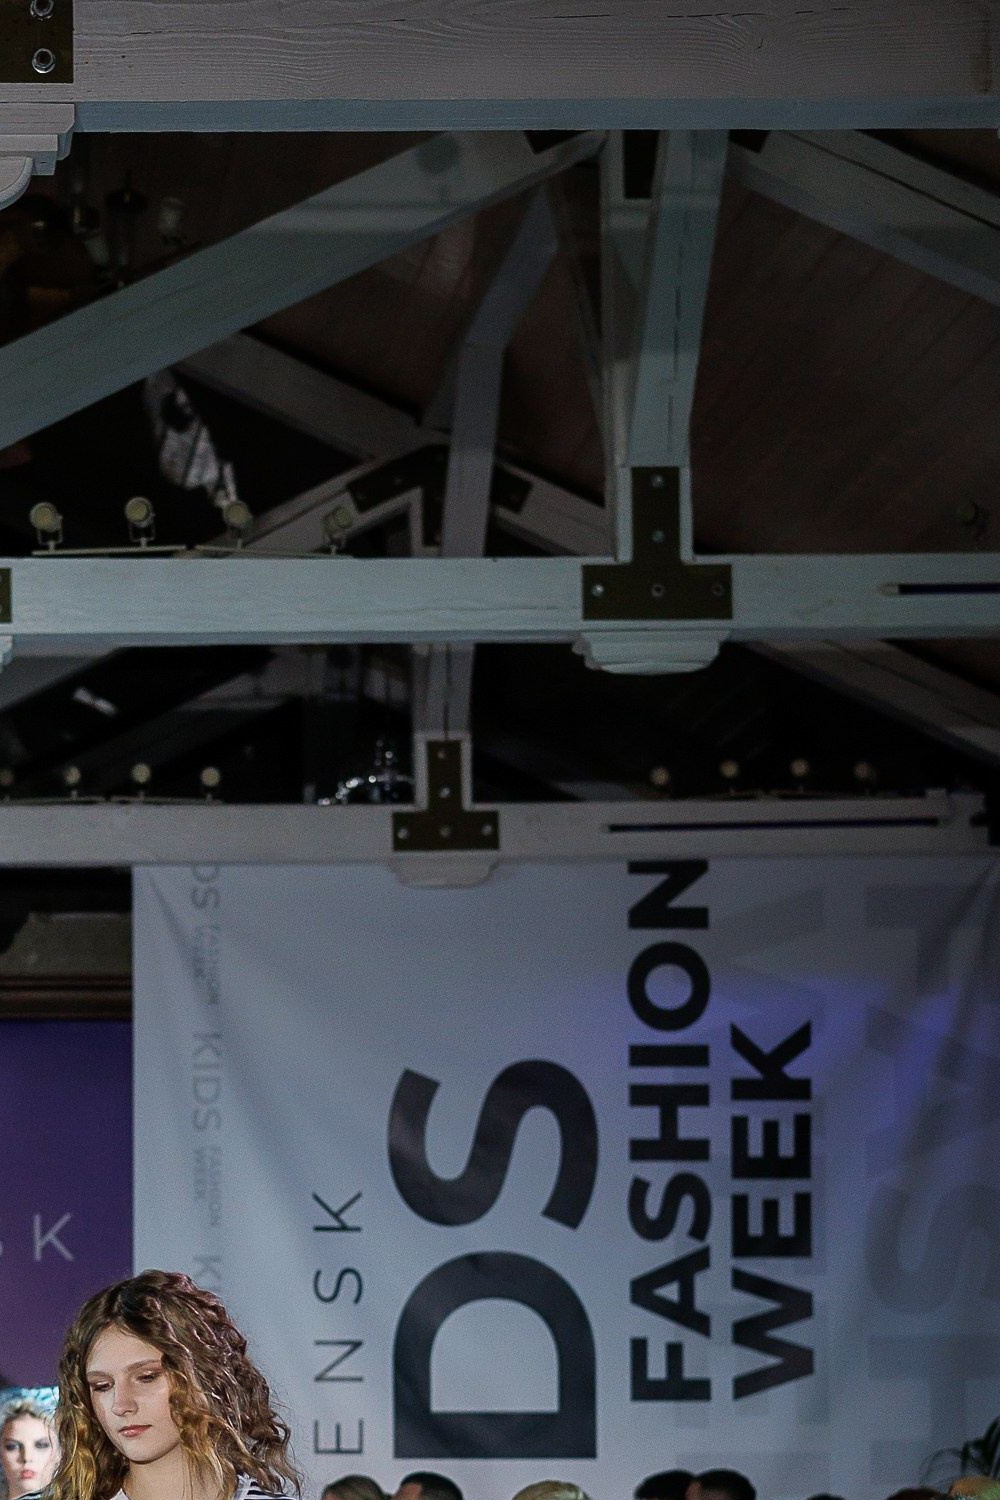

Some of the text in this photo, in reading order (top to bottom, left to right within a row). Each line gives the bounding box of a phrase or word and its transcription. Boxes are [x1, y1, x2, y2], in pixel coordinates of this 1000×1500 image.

[191, 1032, 222, 1132] KIDS
[627, 860, 712, 1402] FASHION
[730, 1020, 814, 1400] WEEK
